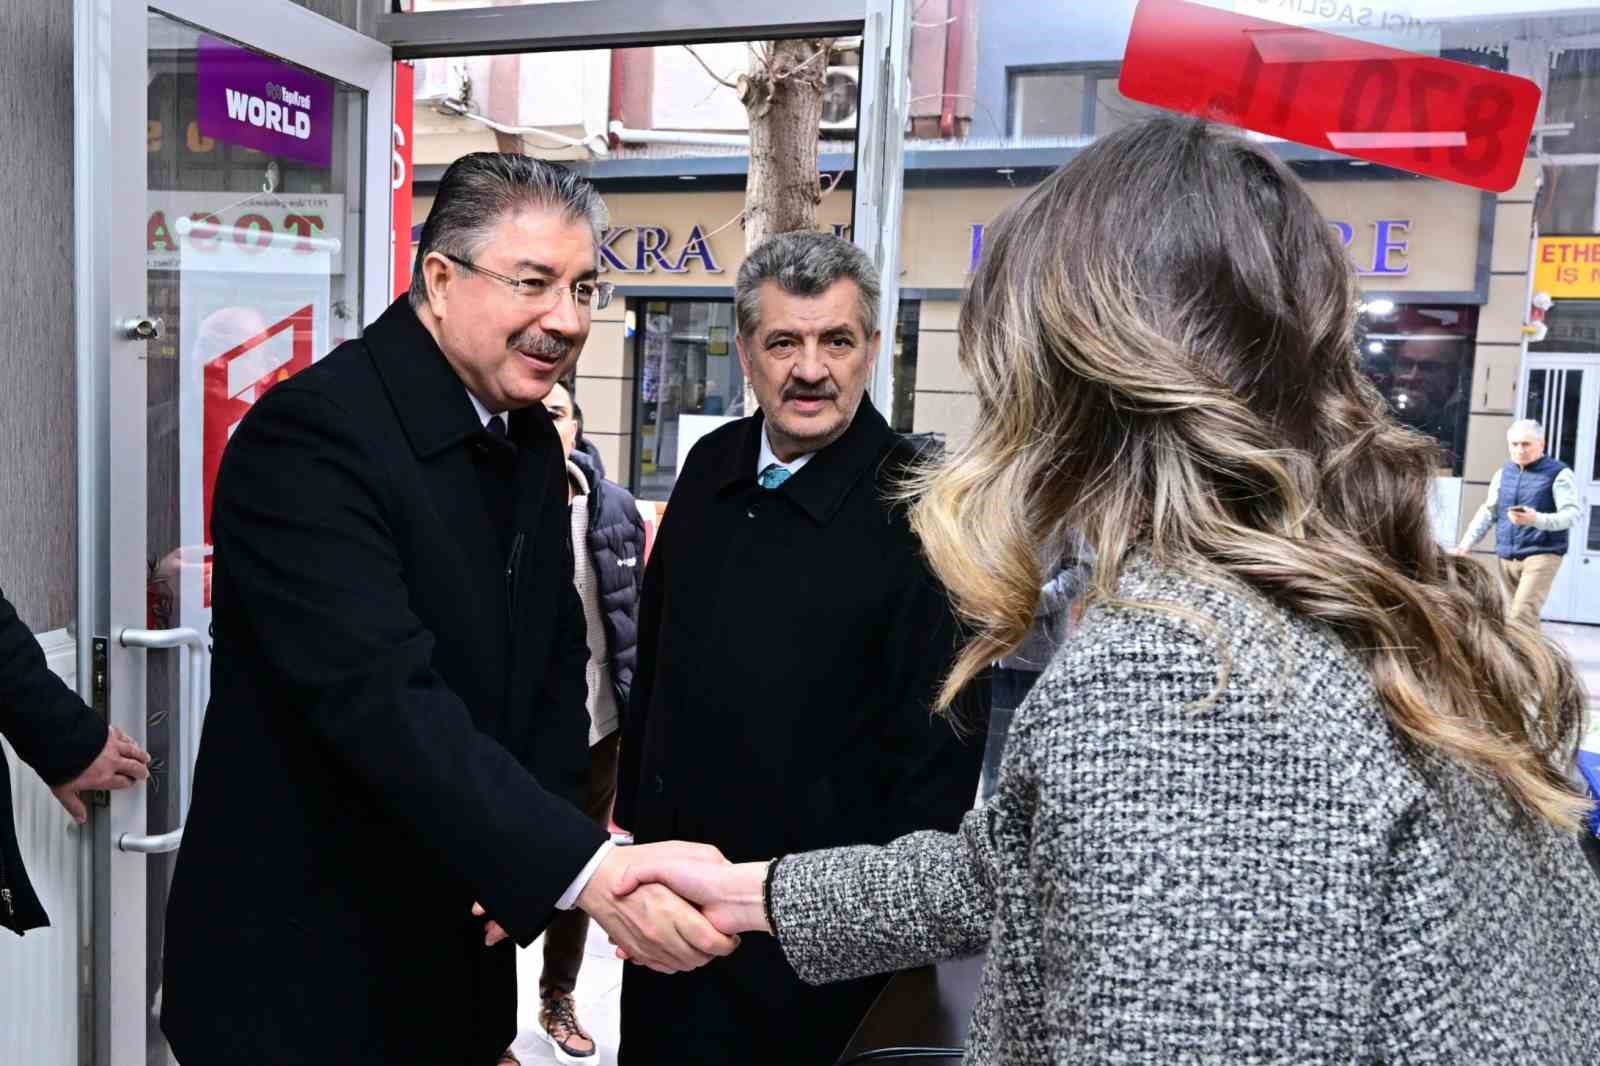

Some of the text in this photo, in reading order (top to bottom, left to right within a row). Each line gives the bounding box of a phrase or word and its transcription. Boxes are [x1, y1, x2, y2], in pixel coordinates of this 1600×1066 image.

[225, 87, 311, 140] WORLD
[592, 218, 1411, 277] KRA RE
